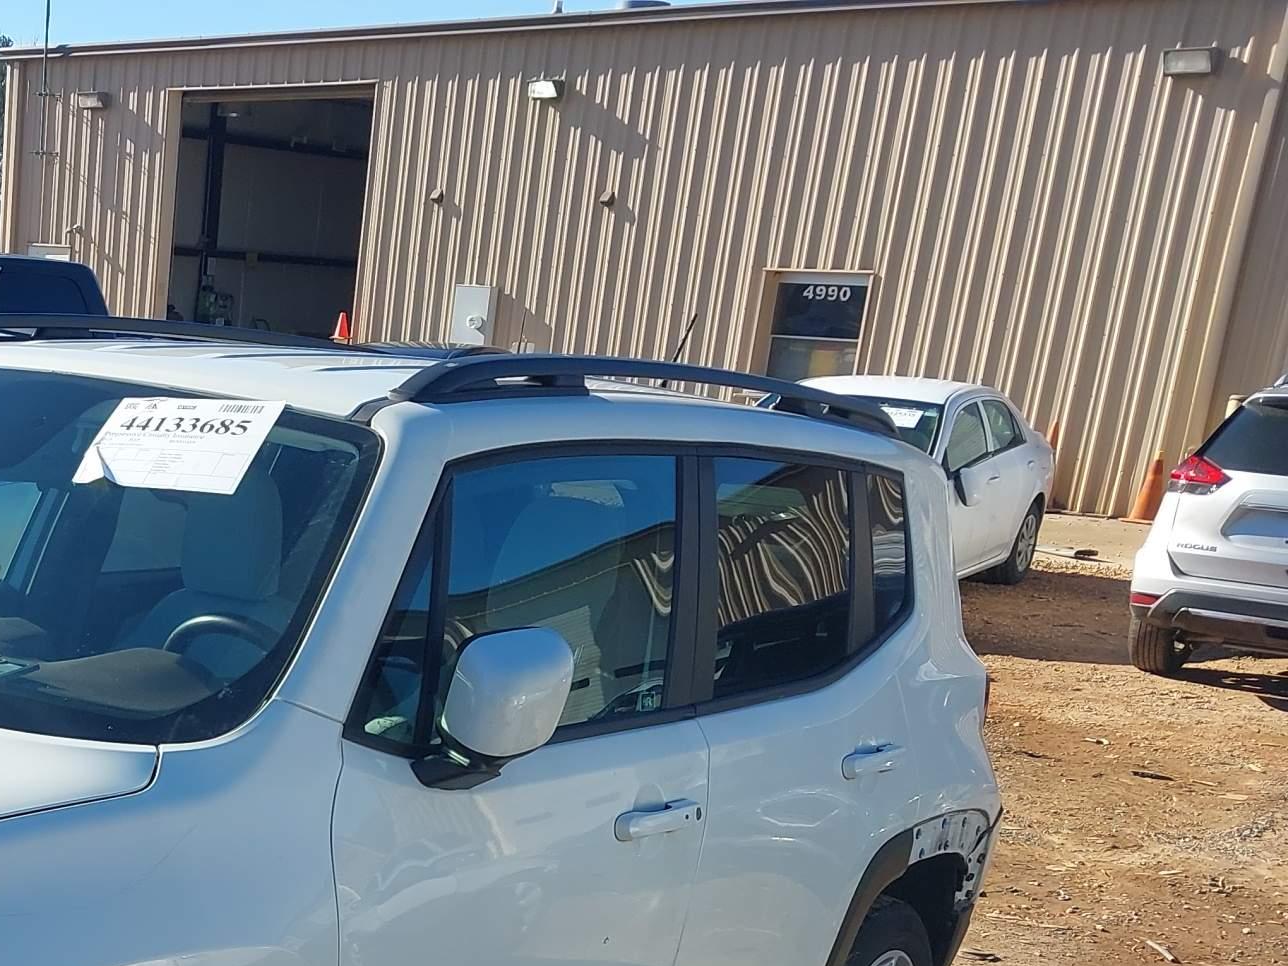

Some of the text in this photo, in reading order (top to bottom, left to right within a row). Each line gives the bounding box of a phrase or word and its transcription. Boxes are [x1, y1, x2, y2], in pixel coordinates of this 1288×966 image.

[803, 285, 852, 302] 4990
[120, 415, 253, 436] 44133685
[1176, 542, 1218, 553] ROGUE
